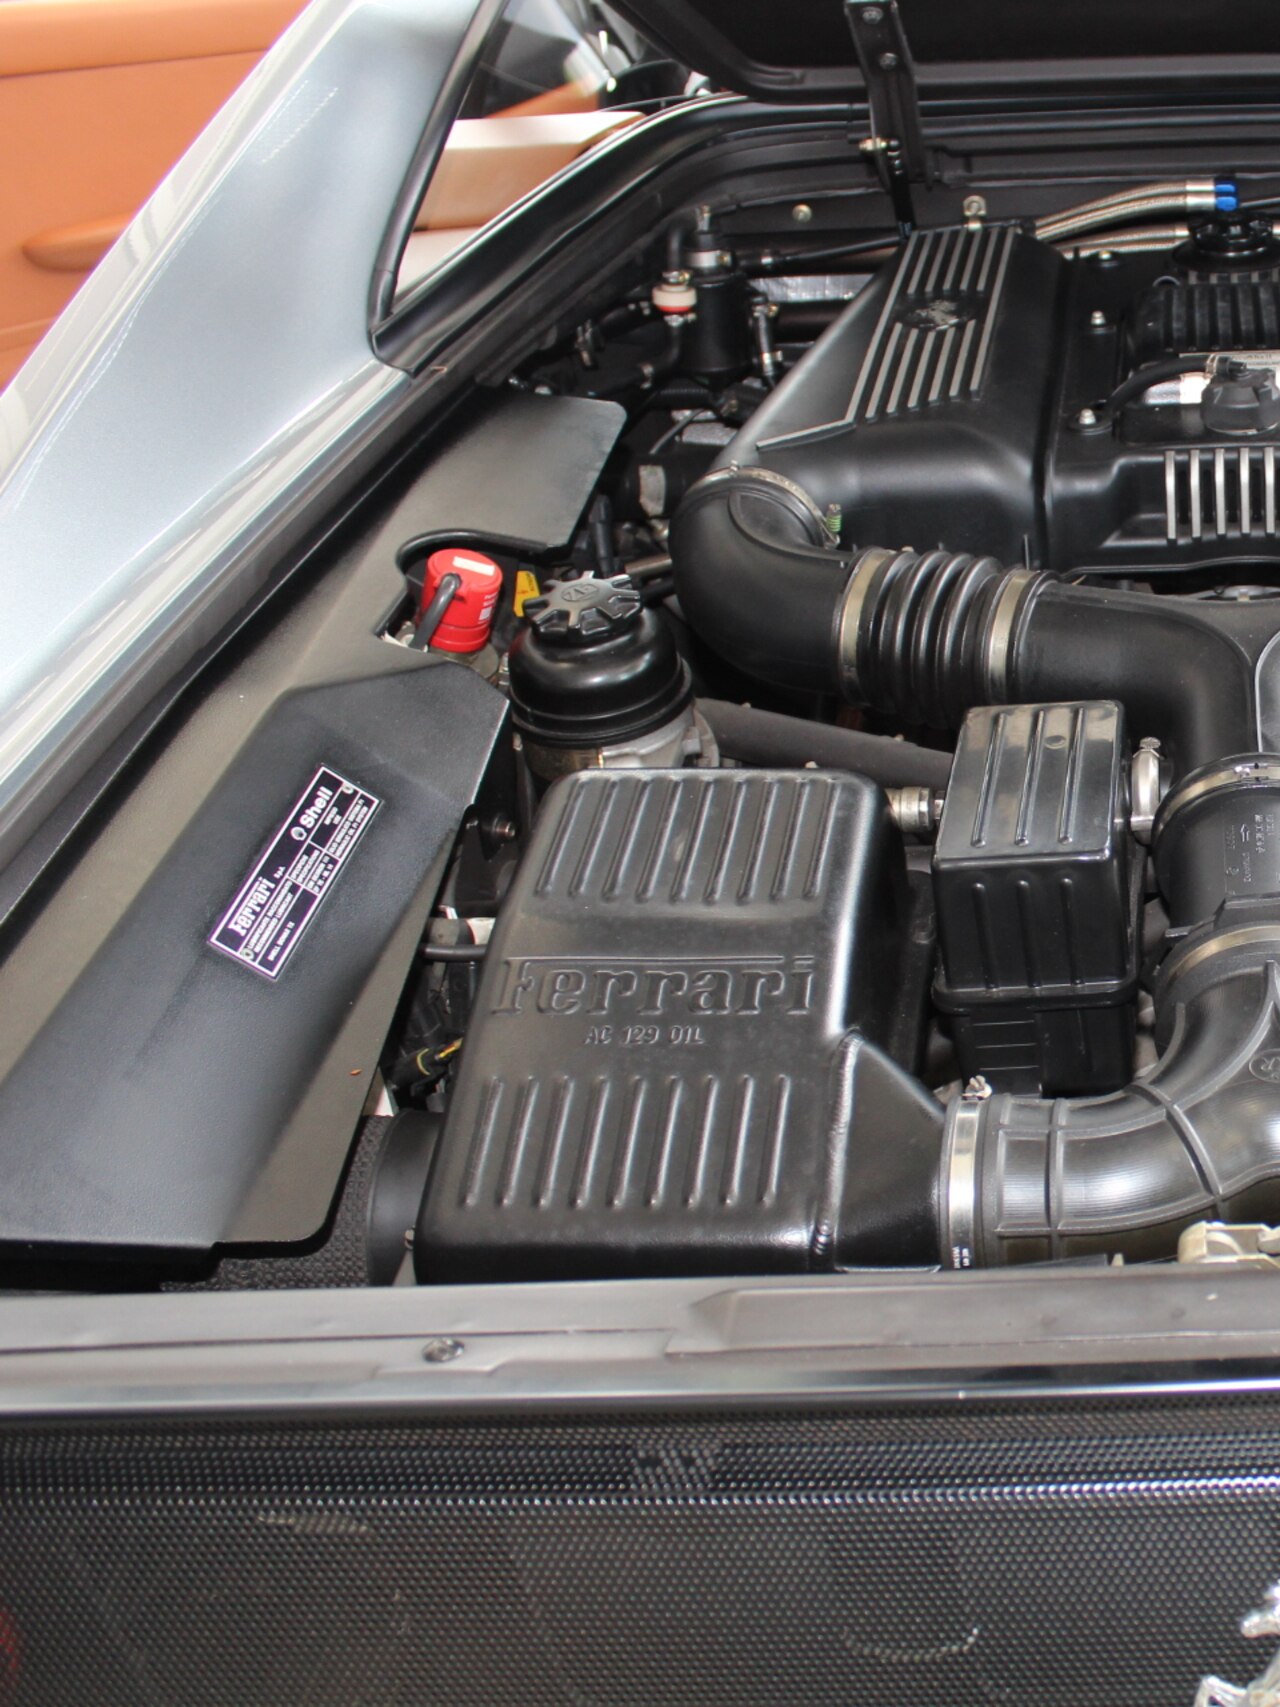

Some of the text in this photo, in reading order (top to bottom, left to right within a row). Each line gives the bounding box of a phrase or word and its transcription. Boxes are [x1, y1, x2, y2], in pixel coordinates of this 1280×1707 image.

[299, 786, 333, 829] Shell
[227, 876, 276, 937] Ferrari
[492, 955, 815, 1015] Ferrari
[622, 1025, 660, 1045] 129
